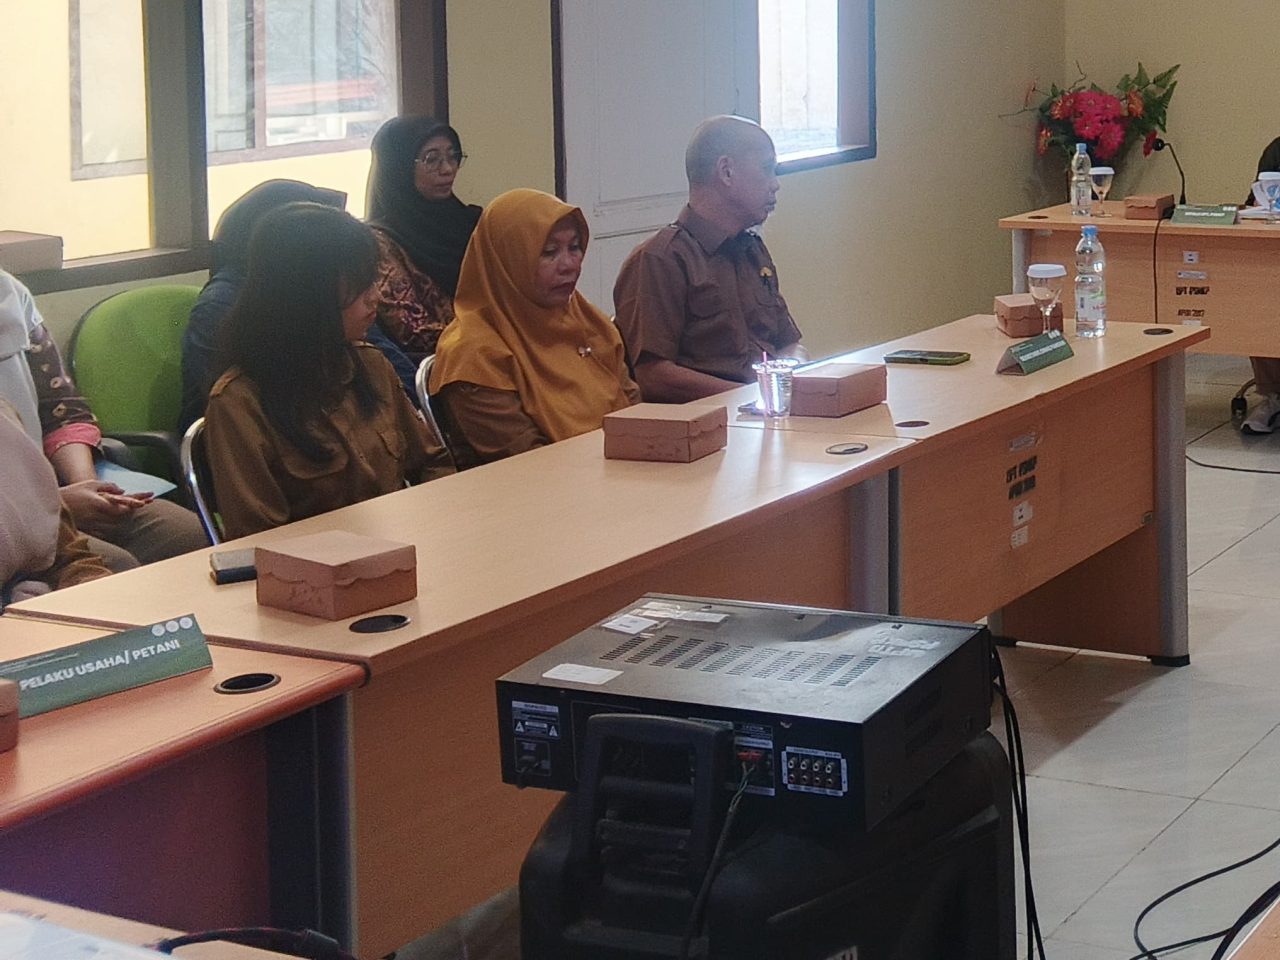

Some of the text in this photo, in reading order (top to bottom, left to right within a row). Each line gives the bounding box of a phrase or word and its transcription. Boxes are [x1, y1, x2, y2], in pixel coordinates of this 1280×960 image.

[19, 667, 74, 691] PELAKU
[75, 650, 130, 675] USAHA/
[132, 639, 181, 661] PETANI
